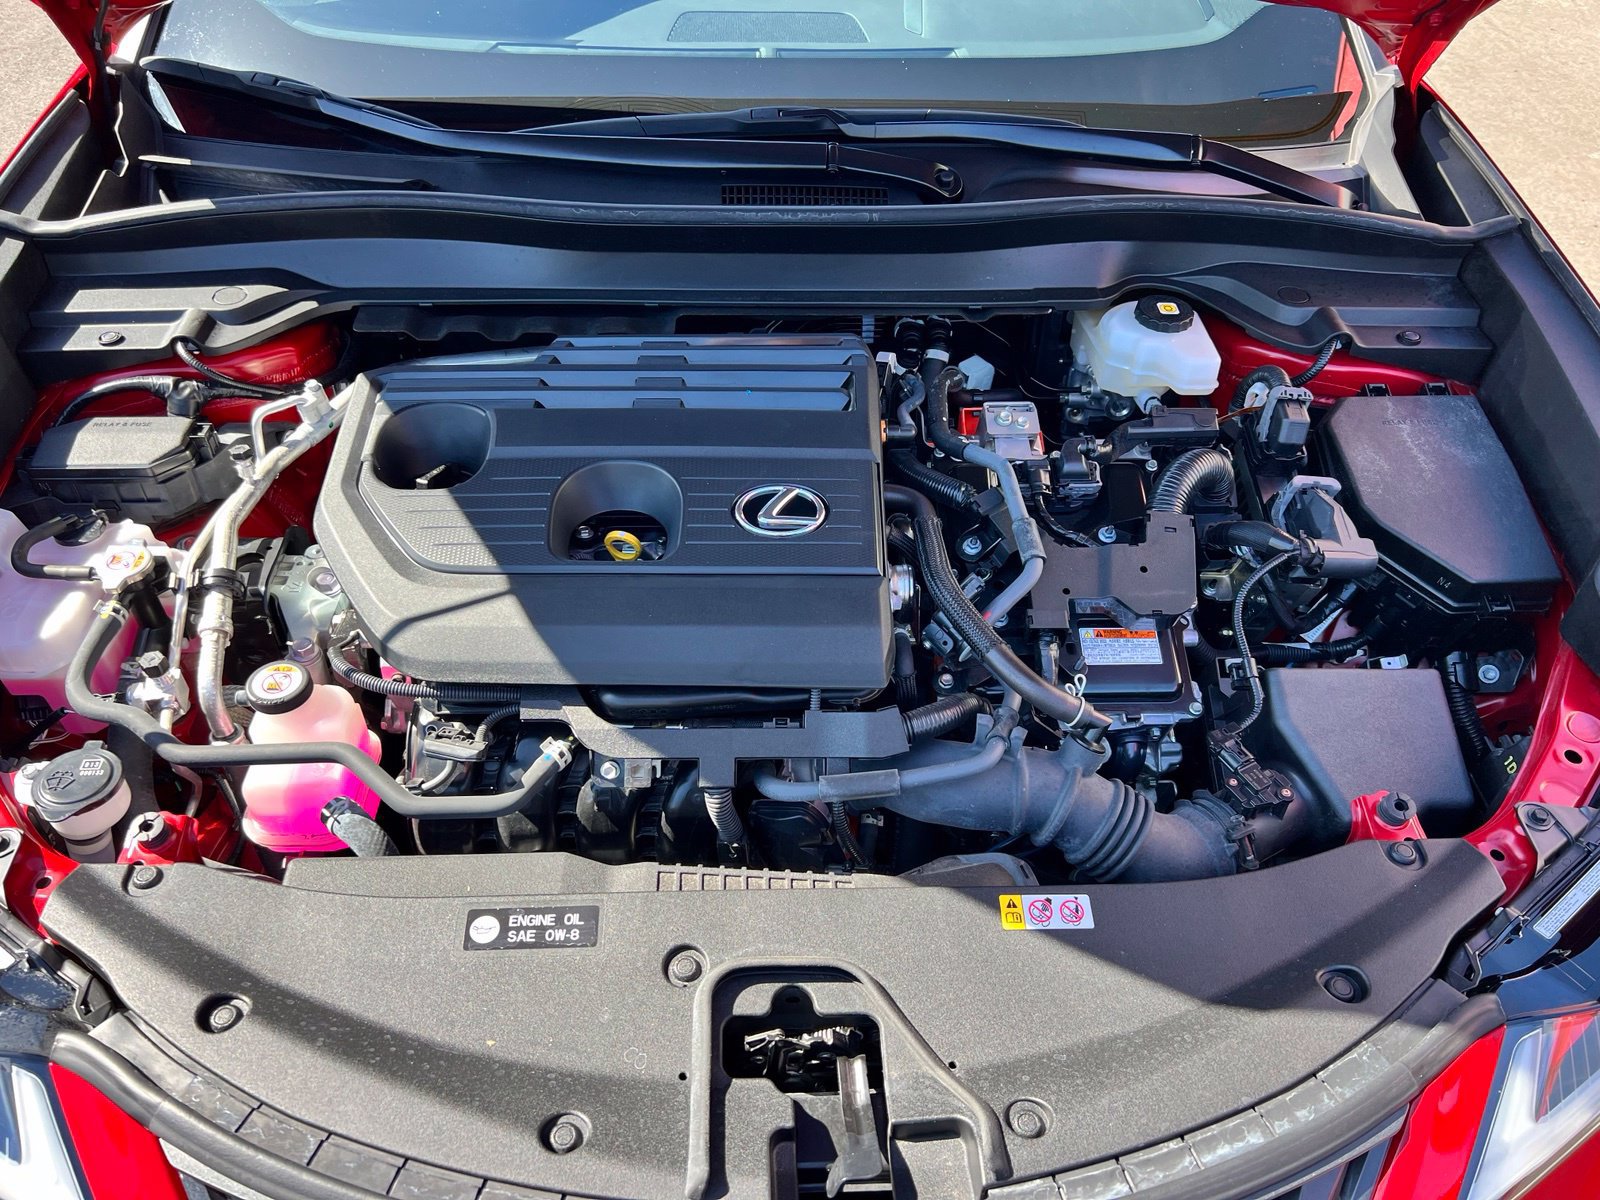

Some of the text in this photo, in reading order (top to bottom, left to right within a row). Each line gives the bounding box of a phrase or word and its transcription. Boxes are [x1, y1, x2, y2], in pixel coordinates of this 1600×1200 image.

[508, 913, 584, 926] ENGINE OIL
[507, 930, 536, 942] SAE
